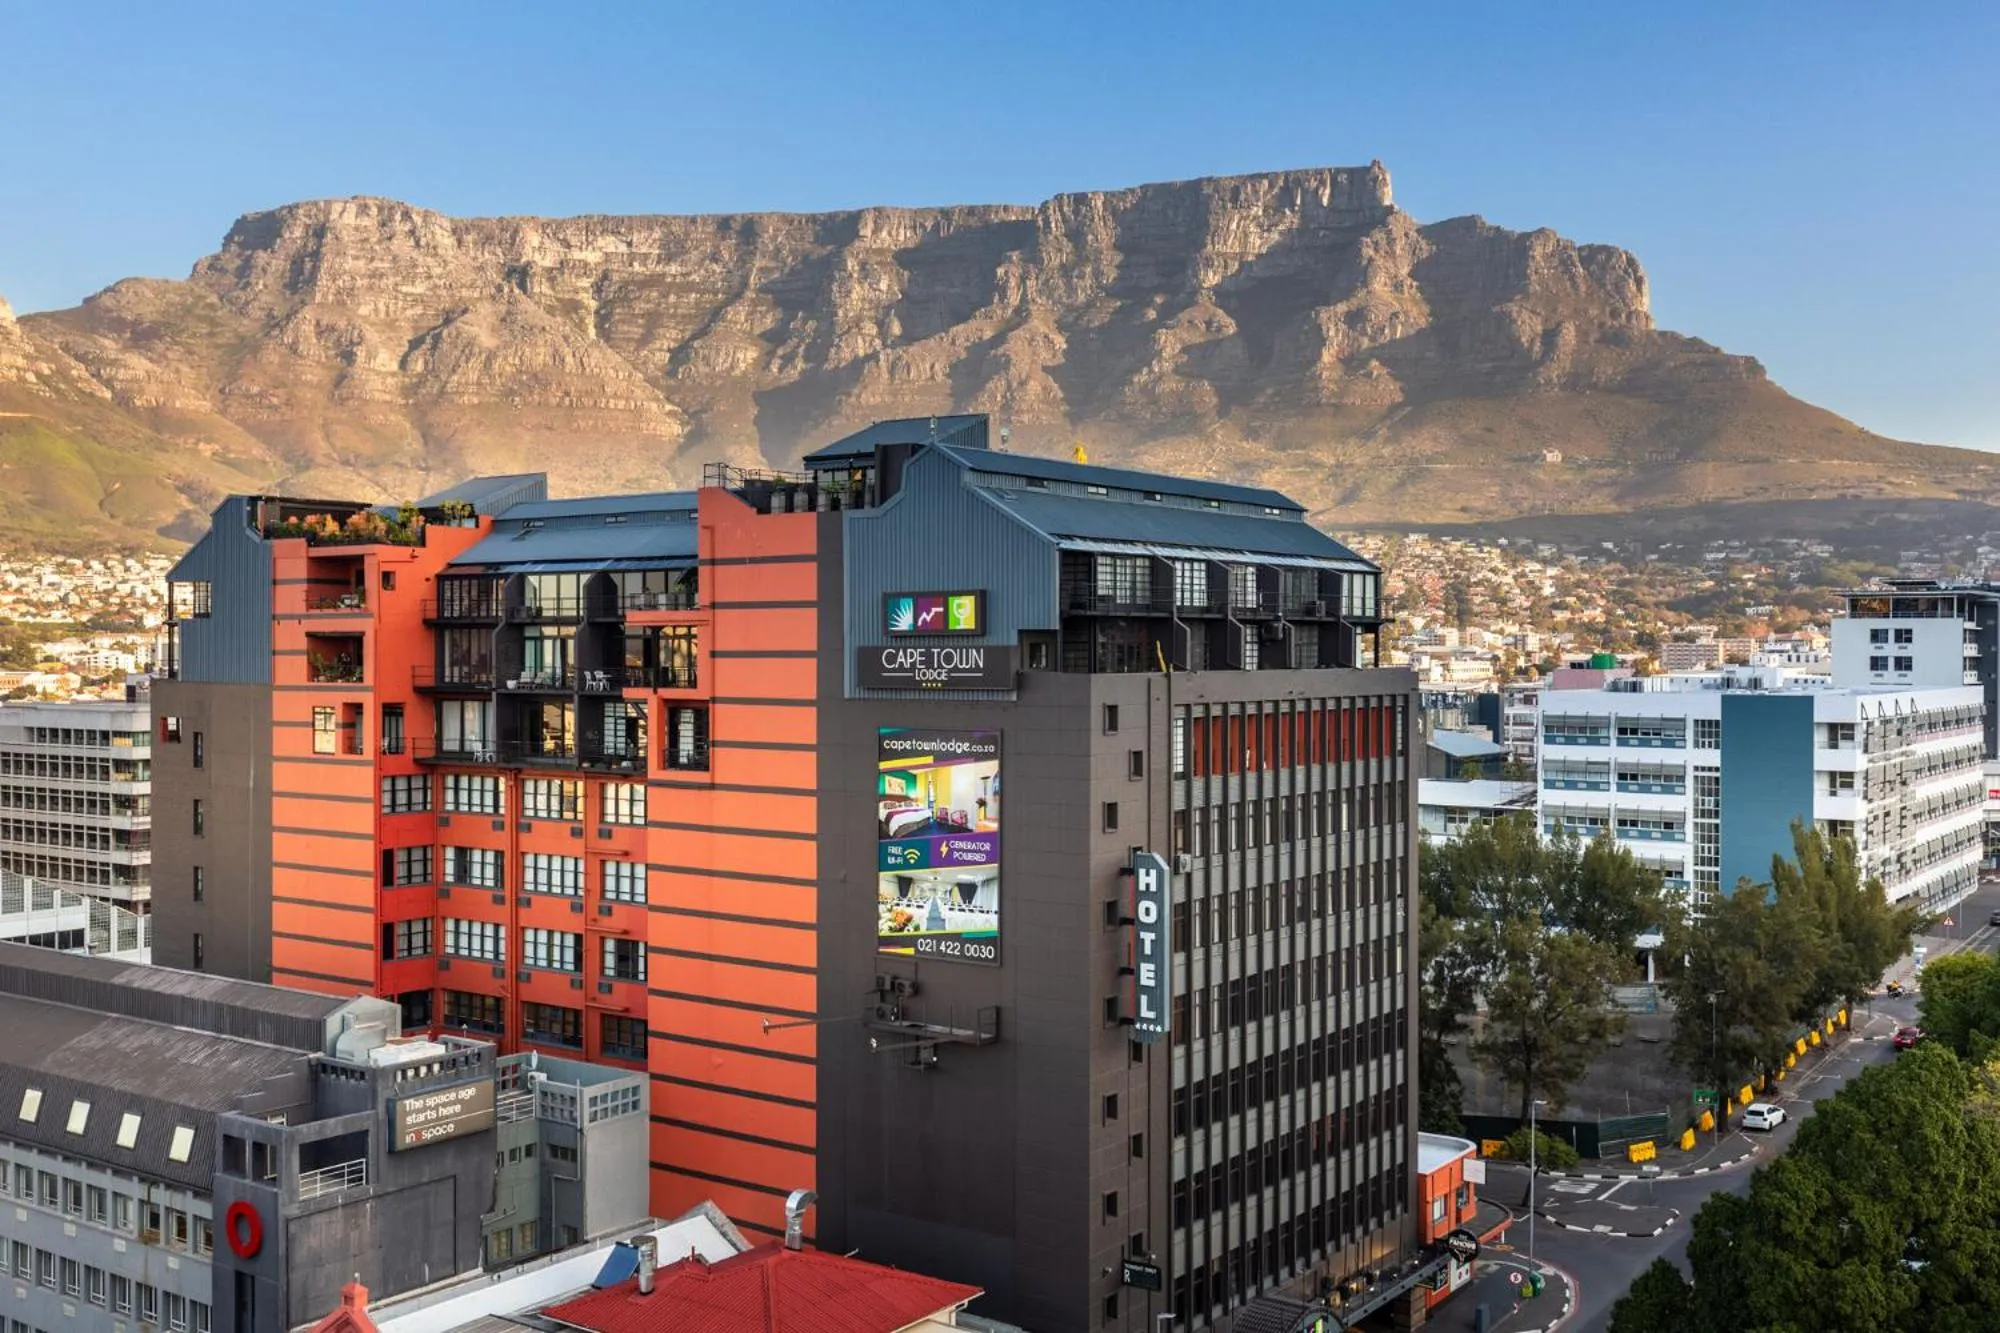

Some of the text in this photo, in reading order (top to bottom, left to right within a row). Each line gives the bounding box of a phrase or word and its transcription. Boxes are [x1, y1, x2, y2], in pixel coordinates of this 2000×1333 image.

[882, 648, 984, 669] CAPE TOWN
[915, 669, 949, 681] LODGE
[883, 737, 995, 754] capetownlodge.co.za
[887, 846, 903, 855] FREE
[949, 840, 991, 851] GENERATOR
[953, 851, 986, 862] POWERED
[917, 938, 995, 959] 021 422 0030
[1137, 867, 1157, 1019] HOTEL
[404, 1087, 476, 1111] The space age
[406, 1104, 461, 1125] starts here
